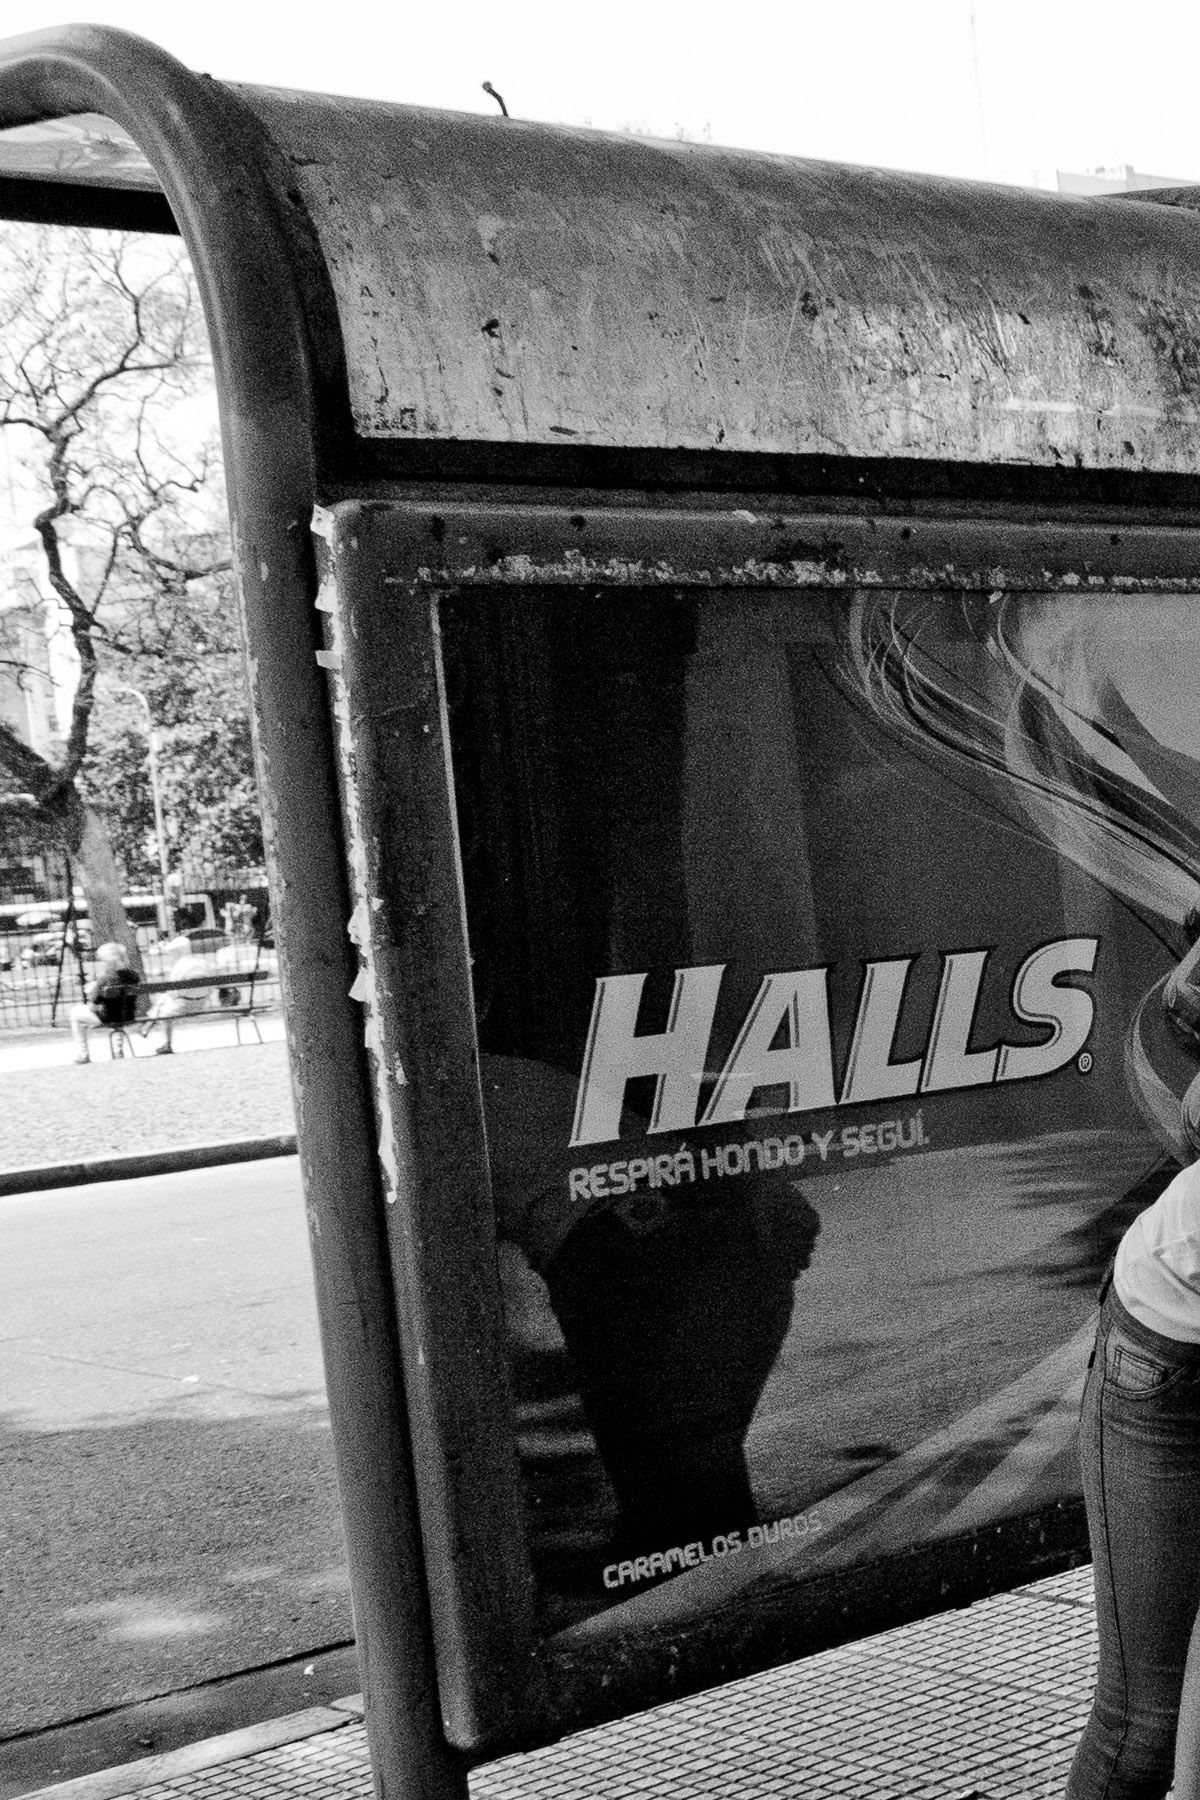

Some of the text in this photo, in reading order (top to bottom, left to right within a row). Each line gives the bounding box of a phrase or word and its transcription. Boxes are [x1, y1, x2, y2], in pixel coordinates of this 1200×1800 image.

[567, 938, 1098, 1148] HALLS
[568, 1142, 696, 1201] RESPIRÁ
[701, 1133, 805, 1180] HONDO
[811, 1129, 834, 1161] Y
[603, 1510, 823, 1589] CARAMELOS DUROS
